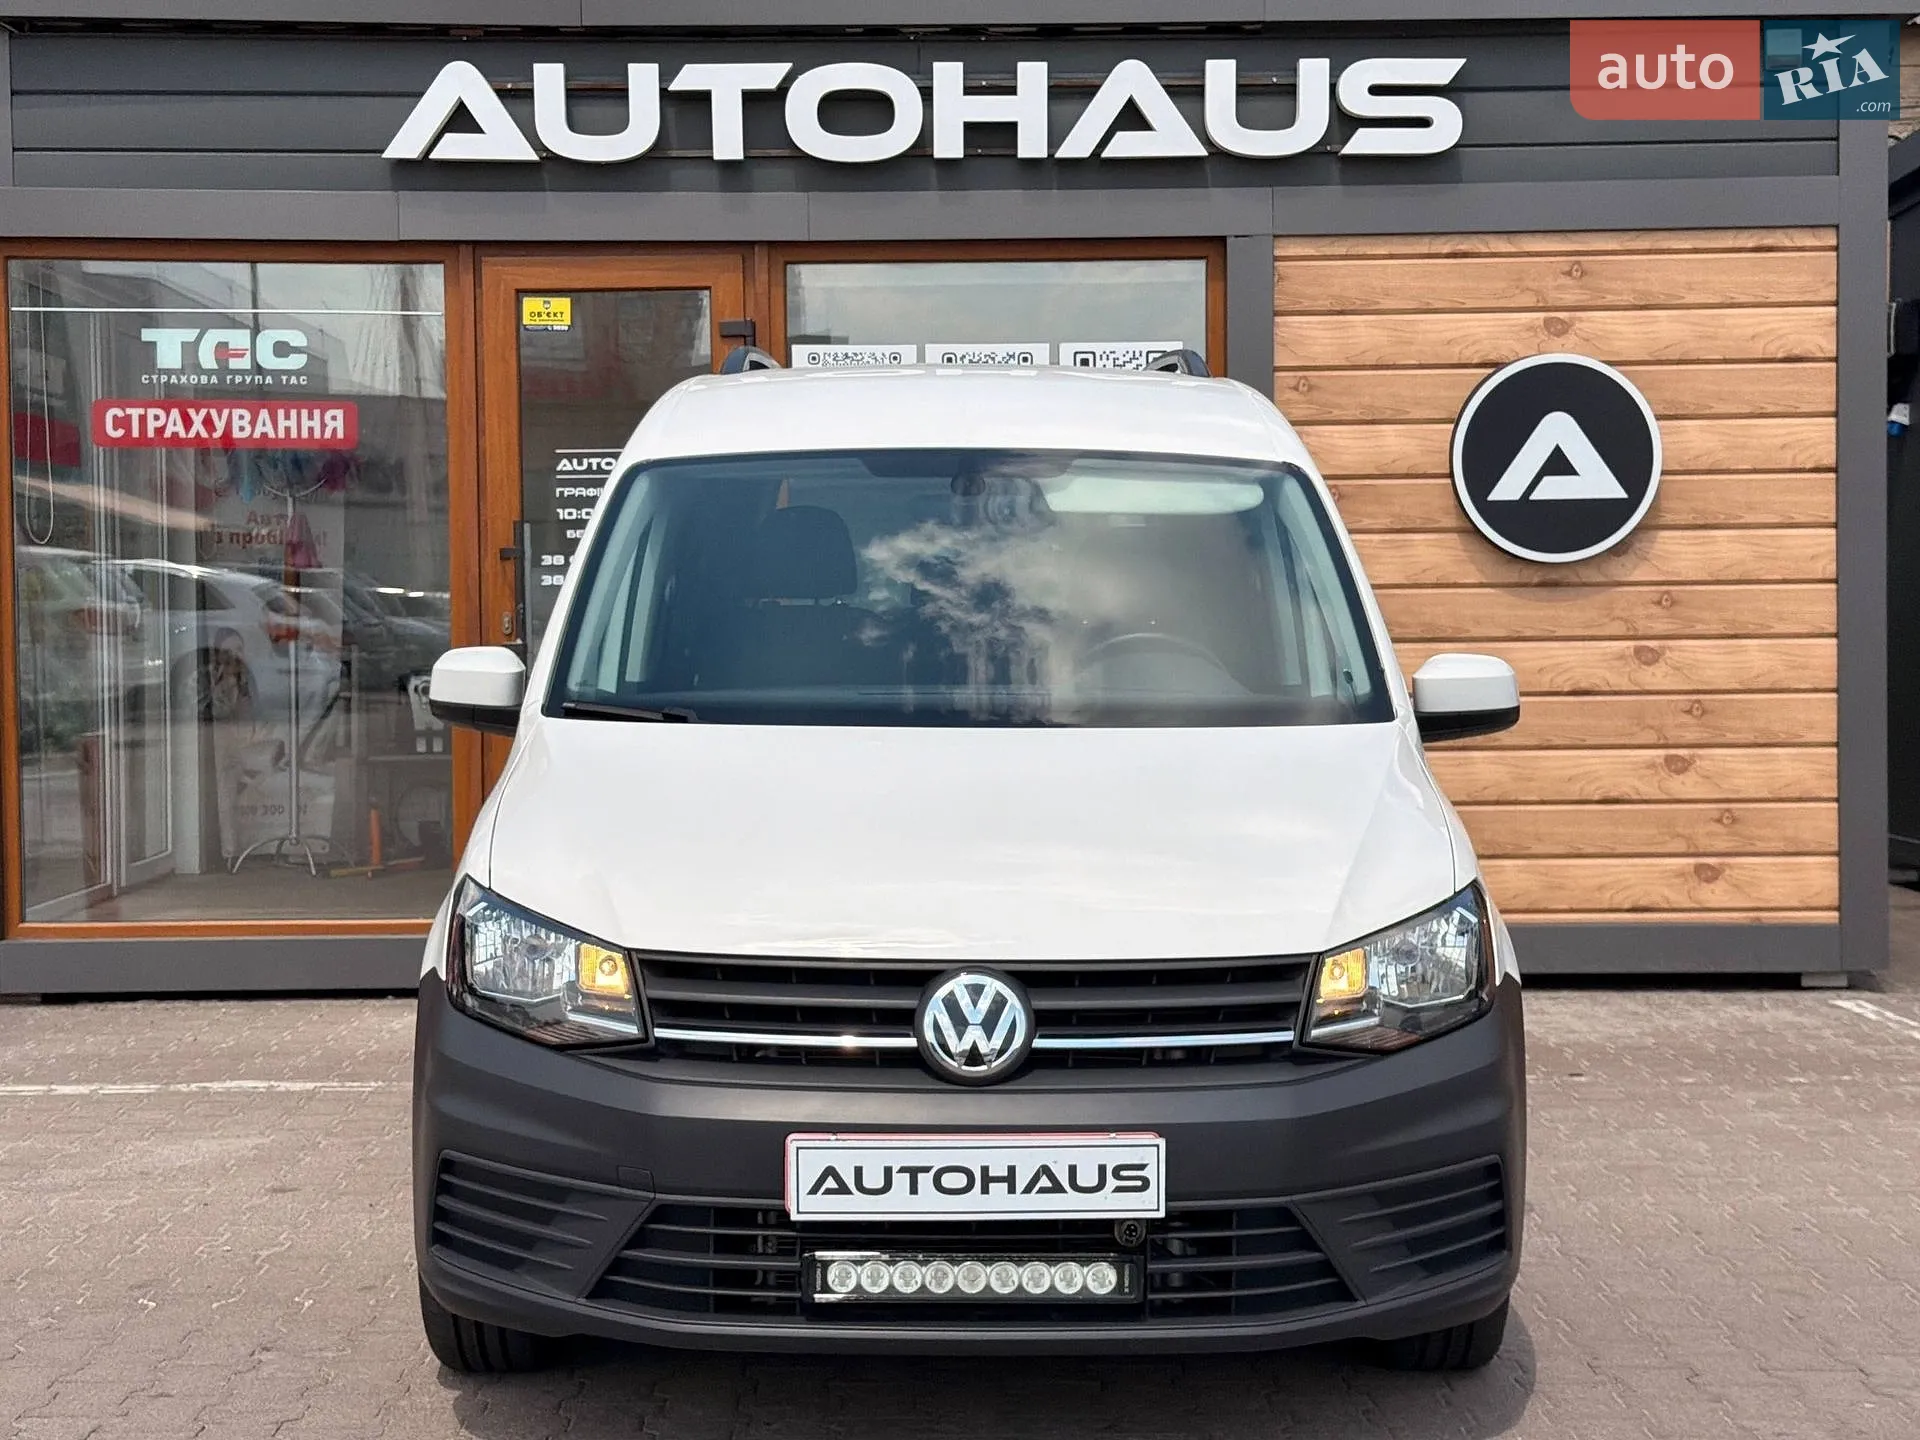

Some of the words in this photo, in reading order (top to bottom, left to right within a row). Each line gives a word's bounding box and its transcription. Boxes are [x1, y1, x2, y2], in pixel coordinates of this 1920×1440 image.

[381, 58, 1467, 163] AUTOHAUS
[141, 374, 219, 386] СТРАХОВА
[226, 374, 274, 386] ГРУПА
[280, 375, 309, 386] ТАС
[104, 407, 345, 440] СТРАХУВАННЯ
[555, 457, 620, 472] AUTO
[555, 486, 604, 499] ГРАФІ
[555, 508, 596, 521] 10:0
[806, 1163, 1151, 1196] AUTOHAUS
